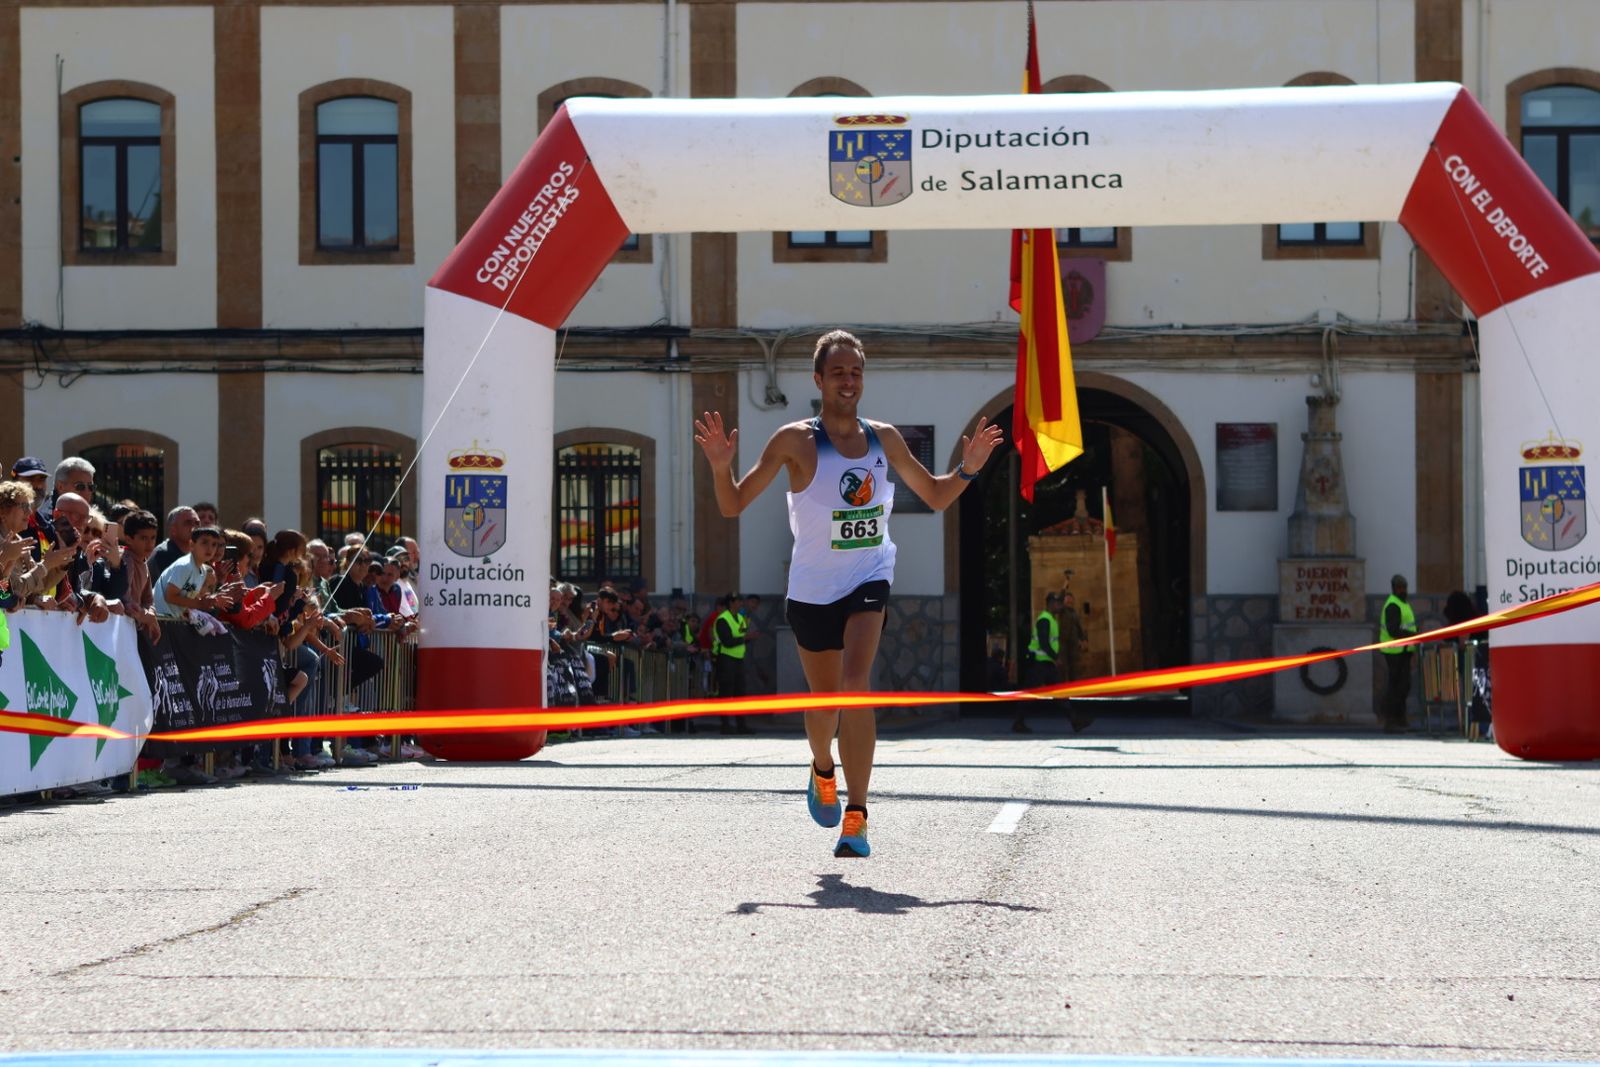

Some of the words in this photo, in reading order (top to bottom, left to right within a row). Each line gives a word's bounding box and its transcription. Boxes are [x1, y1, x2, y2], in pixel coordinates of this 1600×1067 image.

[921, 127, 1089, 153] Diputación
[921, 176, 948, 192] de
[961, 169, 1123, 191] Salamanca
[476, 244, 511, 283] CON
[504, 161, 574, 247] NUESTROS
[1444, 155, 1480, 195] CON
[1471, 188, 1493, 213] EL
[1486, 207, 1549, 279] DEPORTE
[492, 184, 580, 292] DEPORTISTAS
[840, 518, 878, 539] 663
[430, 563, 524, 584] Diputación
[1296, 567, 1349, 579] DIERON
[1317, 581, 1350, 593] VIDA
[1500, 589, 1512, 604] de
[424, 593, 434, 607] de
[439, 588, 531, 608] Salamanca
[1295, 604, 1351, 619] ESPAÑA
